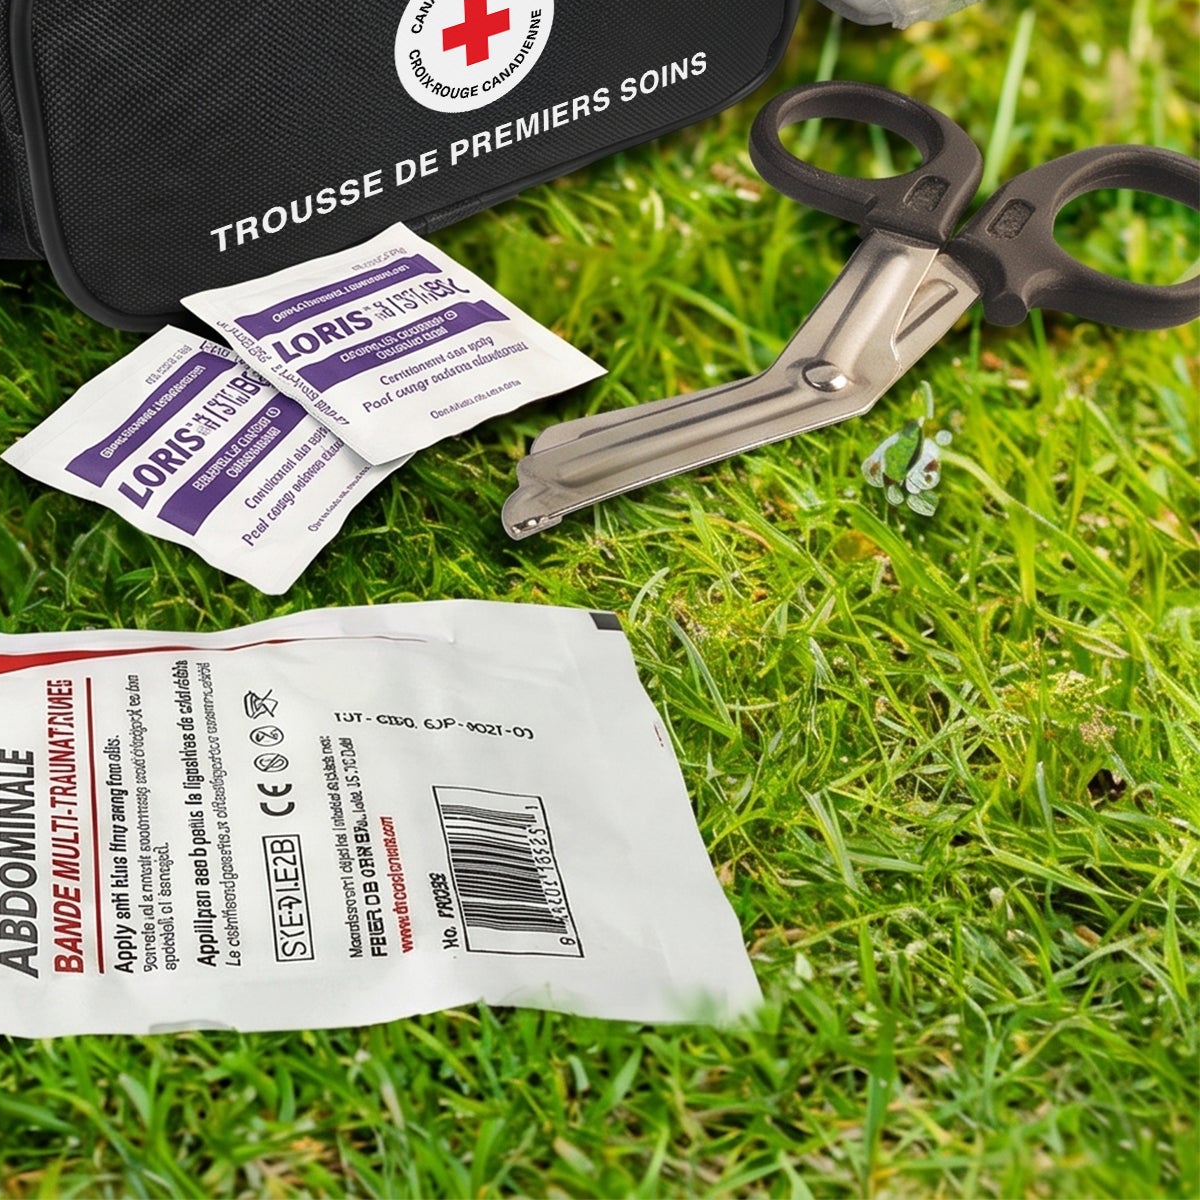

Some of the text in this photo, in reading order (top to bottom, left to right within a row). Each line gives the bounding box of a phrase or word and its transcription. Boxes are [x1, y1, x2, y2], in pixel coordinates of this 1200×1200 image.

[408, 8, 542, 99] CROIX-ROUGE CANADIENNE
[210, 51, 708, 253] TROUSSE DE PREMIERS SOINS
[271, 310, 373, 364] LORIS
[117, 427, 206, 510] LORIS
[256, 782, 295, 818] CE
[52, 884, 84, 974] BANDE
[113, 924, 138, 974] Apply
